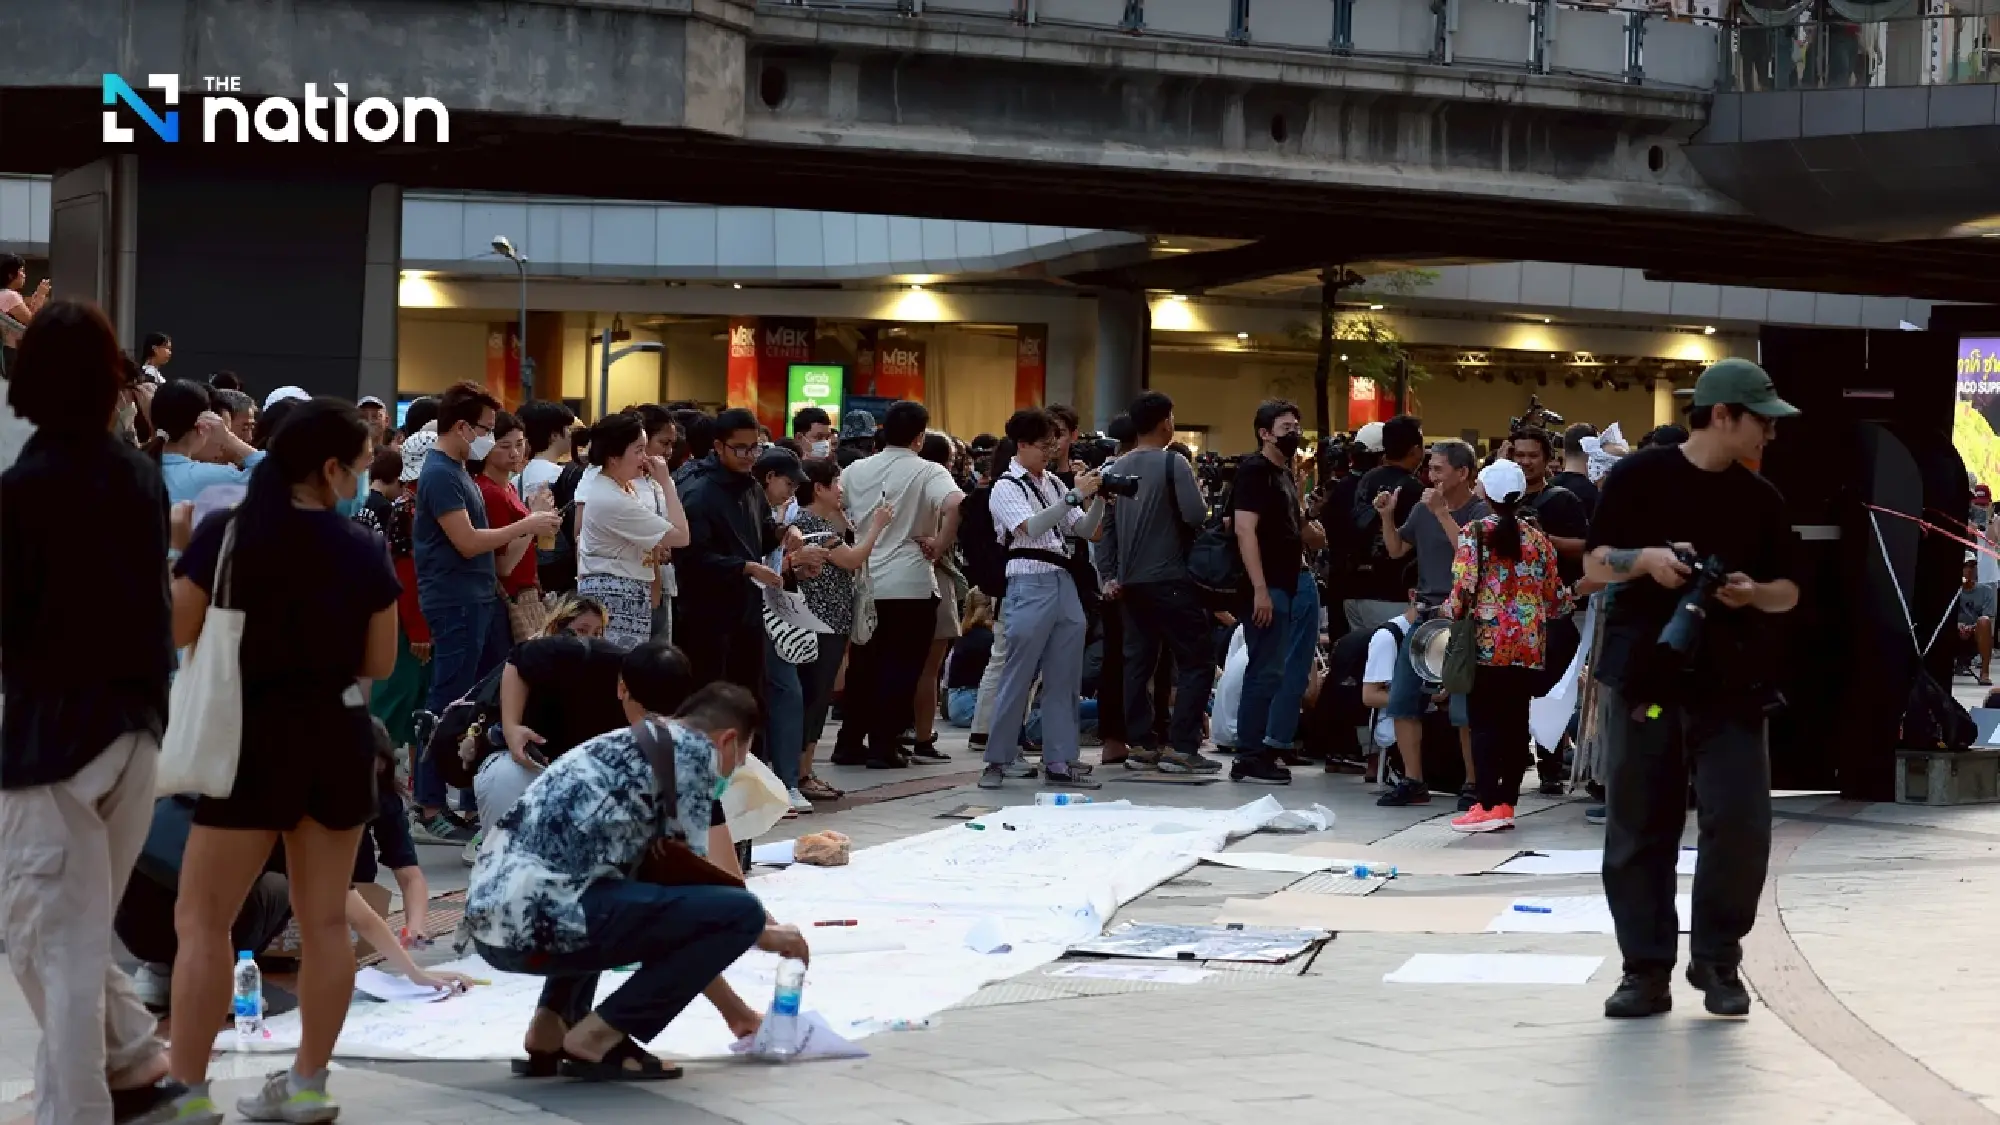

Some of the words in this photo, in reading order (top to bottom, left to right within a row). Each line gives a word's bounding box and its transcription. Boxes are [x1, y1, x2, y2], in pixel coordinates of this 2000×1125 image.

[731, 325, 755, 346] MBK
[765, 325, 809, 347] MBK
[882, 348, 919, 366] MBK
